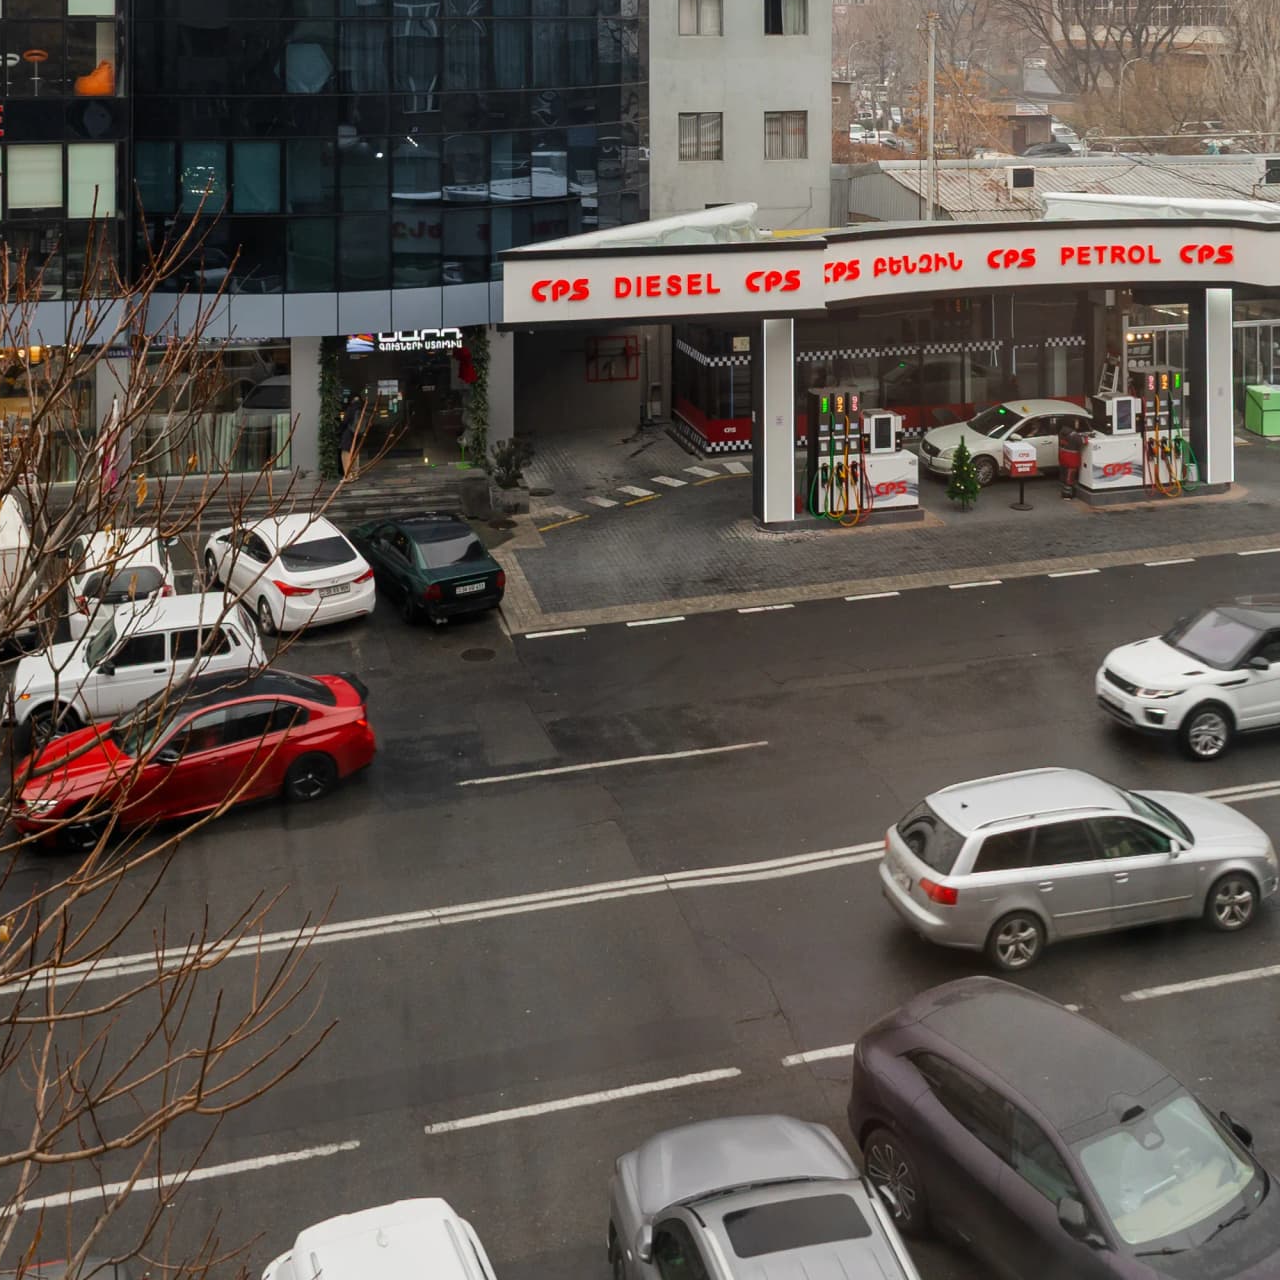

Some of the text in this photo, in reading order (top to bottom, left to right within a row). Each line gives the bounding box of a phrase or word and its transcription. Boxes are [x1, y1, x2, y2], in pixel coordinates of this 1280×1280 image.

[873, 251, 964, 279] ԲԵՆԶԻՆ
[986, 247, 1037, 270] CPS
[1060, 244, 1162, 267] PETROL
[1179, 244, 1235, 266] CPS
[531, 269, 801, 302] CPS DIESEL CPS
[836, 396, 844, 413] 92
[851, 395, 858, 412] 95
[1103, 463, 1132, 477] CPS
[875, 481, 907, 496] CPS
